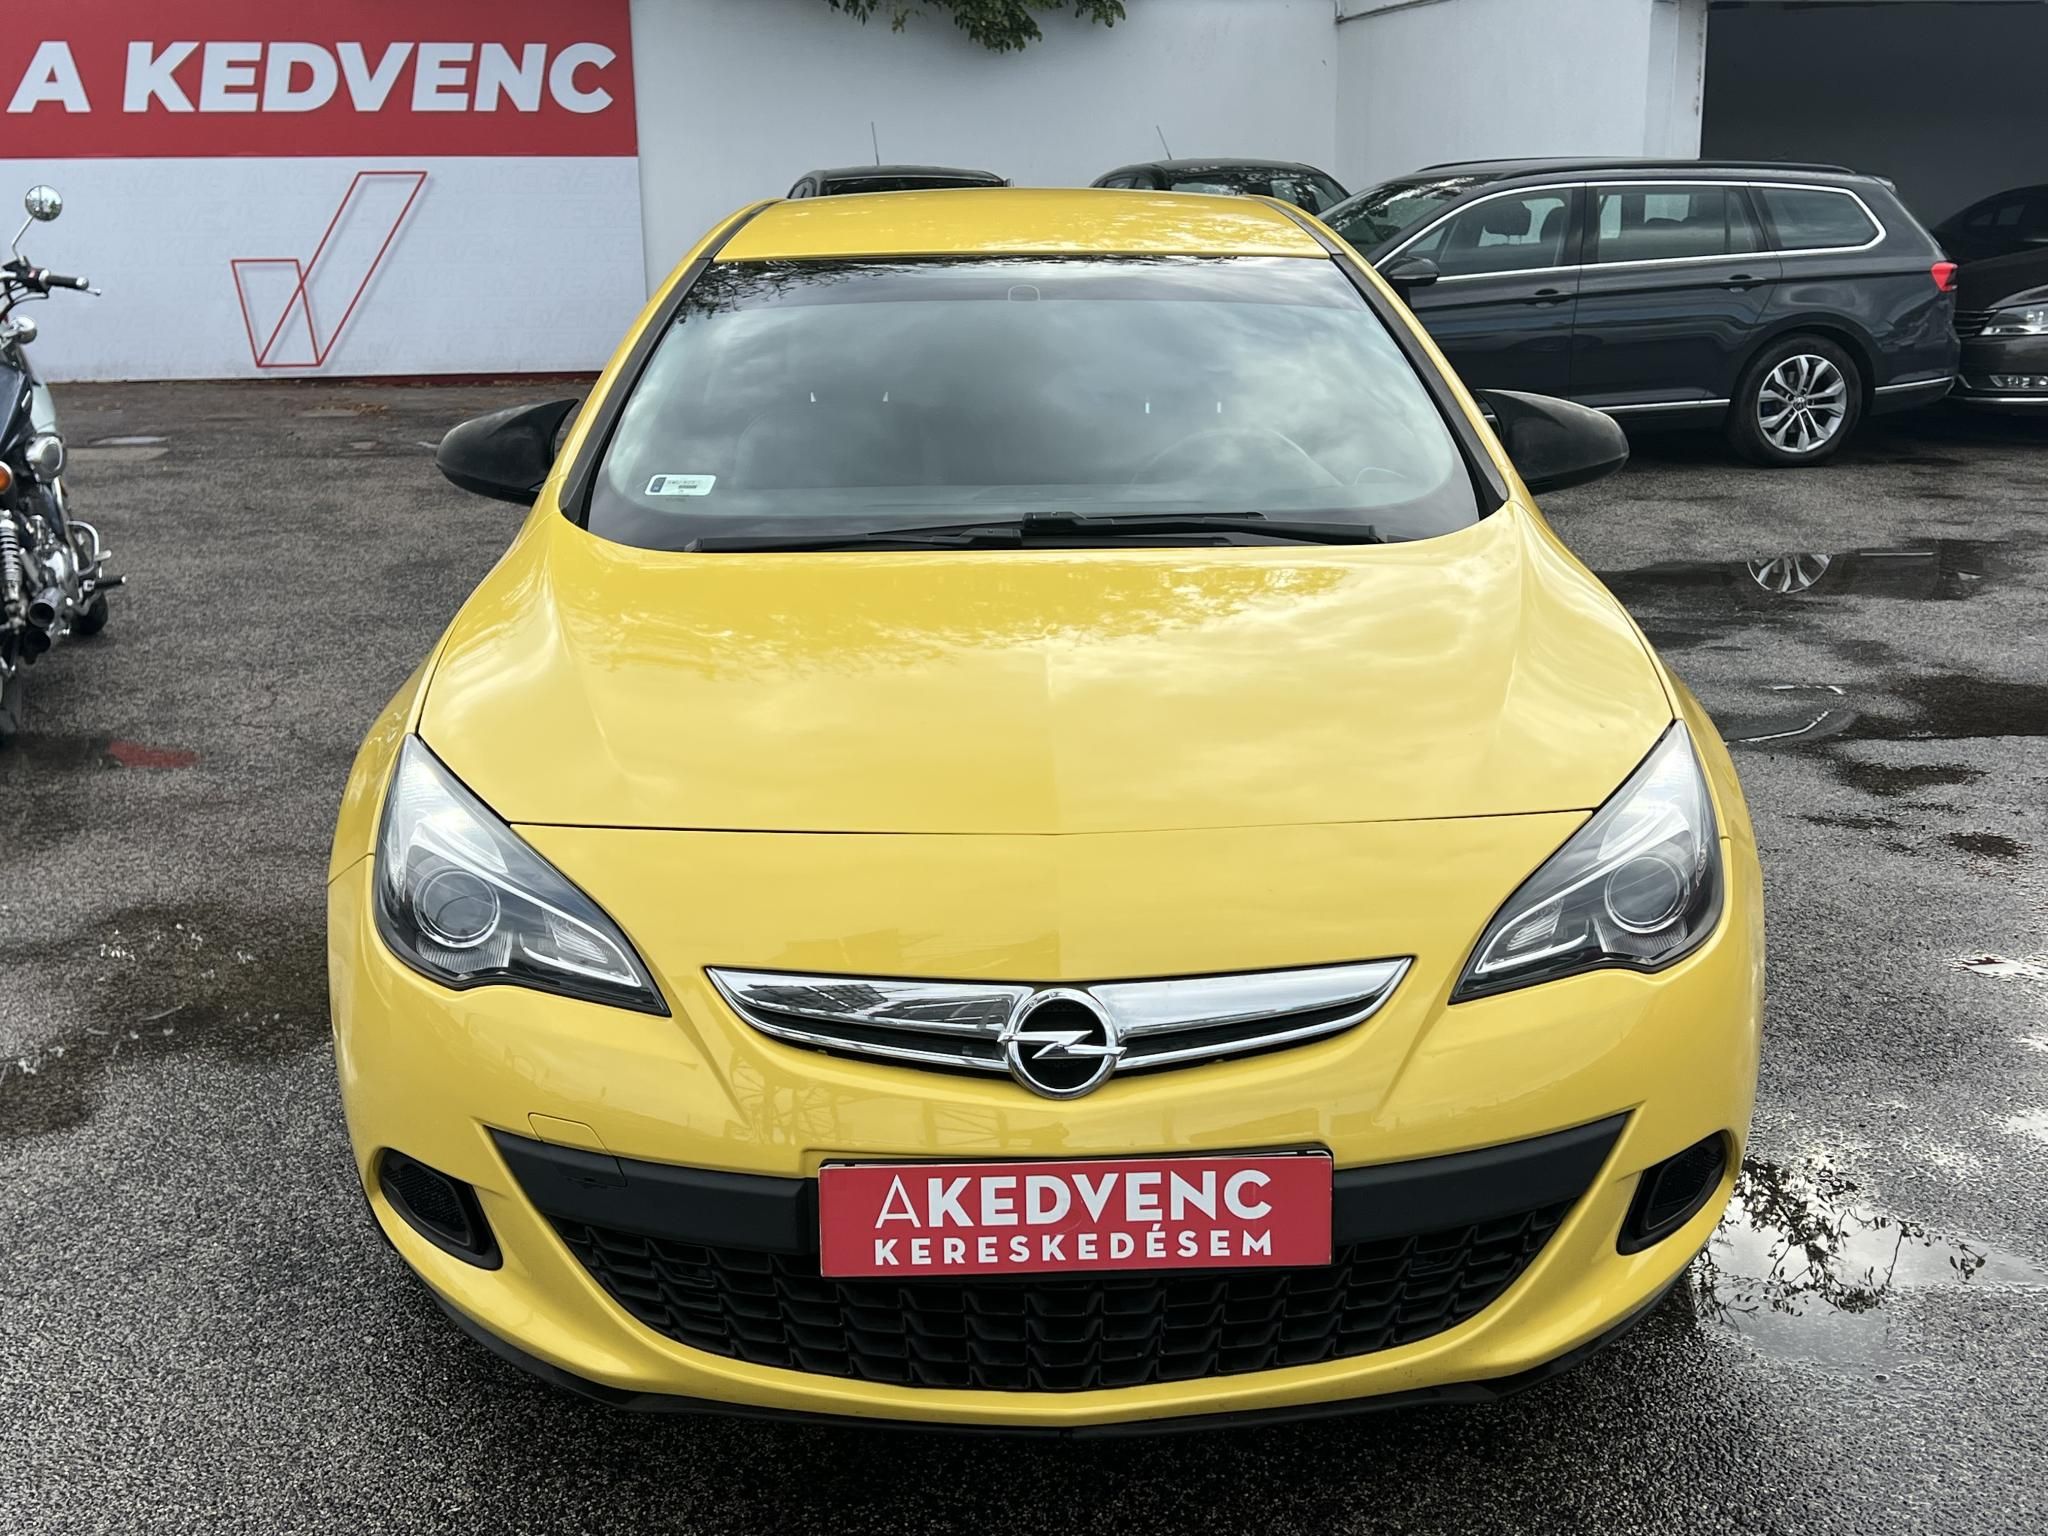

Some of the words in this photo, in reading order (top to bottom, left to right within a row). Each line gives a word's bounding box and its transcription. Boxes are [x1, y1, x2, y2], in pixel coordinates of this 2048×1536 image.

[7, 41, 91, 113] A
[124, 41, 616, 114] KEDVENC
[875, 1224, 1272, 1266] KERESKEDÉSEM
